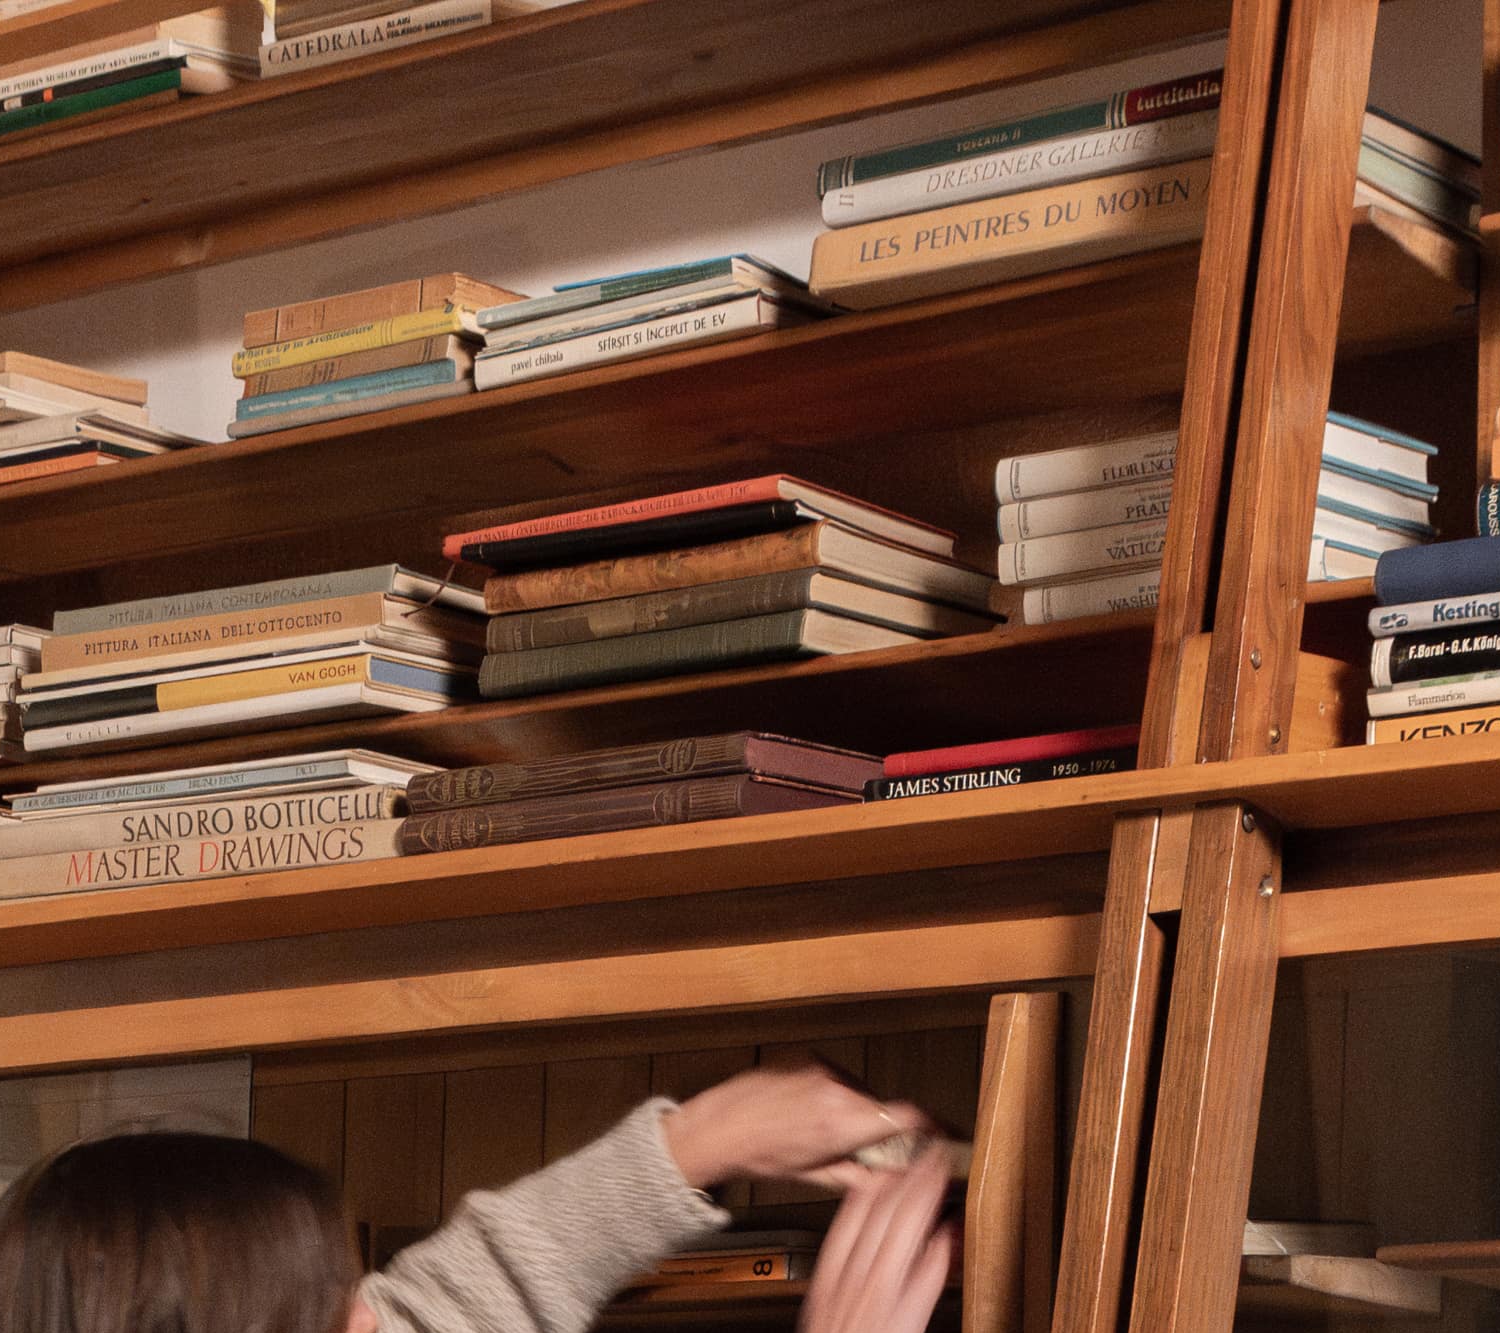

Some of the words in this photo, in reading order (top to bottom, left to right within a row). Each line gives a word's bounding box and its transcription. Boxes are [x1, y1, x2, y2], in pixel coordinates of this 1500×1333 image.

[267, 25, 384, 65] CATEDRALA
[46, 70, 76, 85] MUSEUM
[926, 150, 1042, 194] DRESDNER
[859, 236, 901, 263] LES
[914, 209, 1030, 254] PEINTRES
[1044, 198, 1082, 228] DU
[1095, 176, 1191, 218] MOYEN
[694, 315, 707, 330] DE
[712, 312, 727, 327] EV
[1432, 600, 1500, 623] Kesting
[85, 639, 139, 656] PITTURA
[148, 628, 212, 648] ITALIANA
[221, 610, 344, 640] DELL'OTTOCENTO
[288, 670, 316, 685] VAN
[318, 663, 357, 680] GOGH
[885, 777, 940, 800] JAMES
[942, 767, 1022, 794] STIRLING
[1051, 763, 1079, 777] 1950
[122, 806, 235, 843] SANDRO
[244, 790, 384, 832] BOTTICELLI
[66, 843, 185, 886] MASTER
[198, 826, 365, 873] DRAWINGS
[752, 1259, 773, 1276] 8
